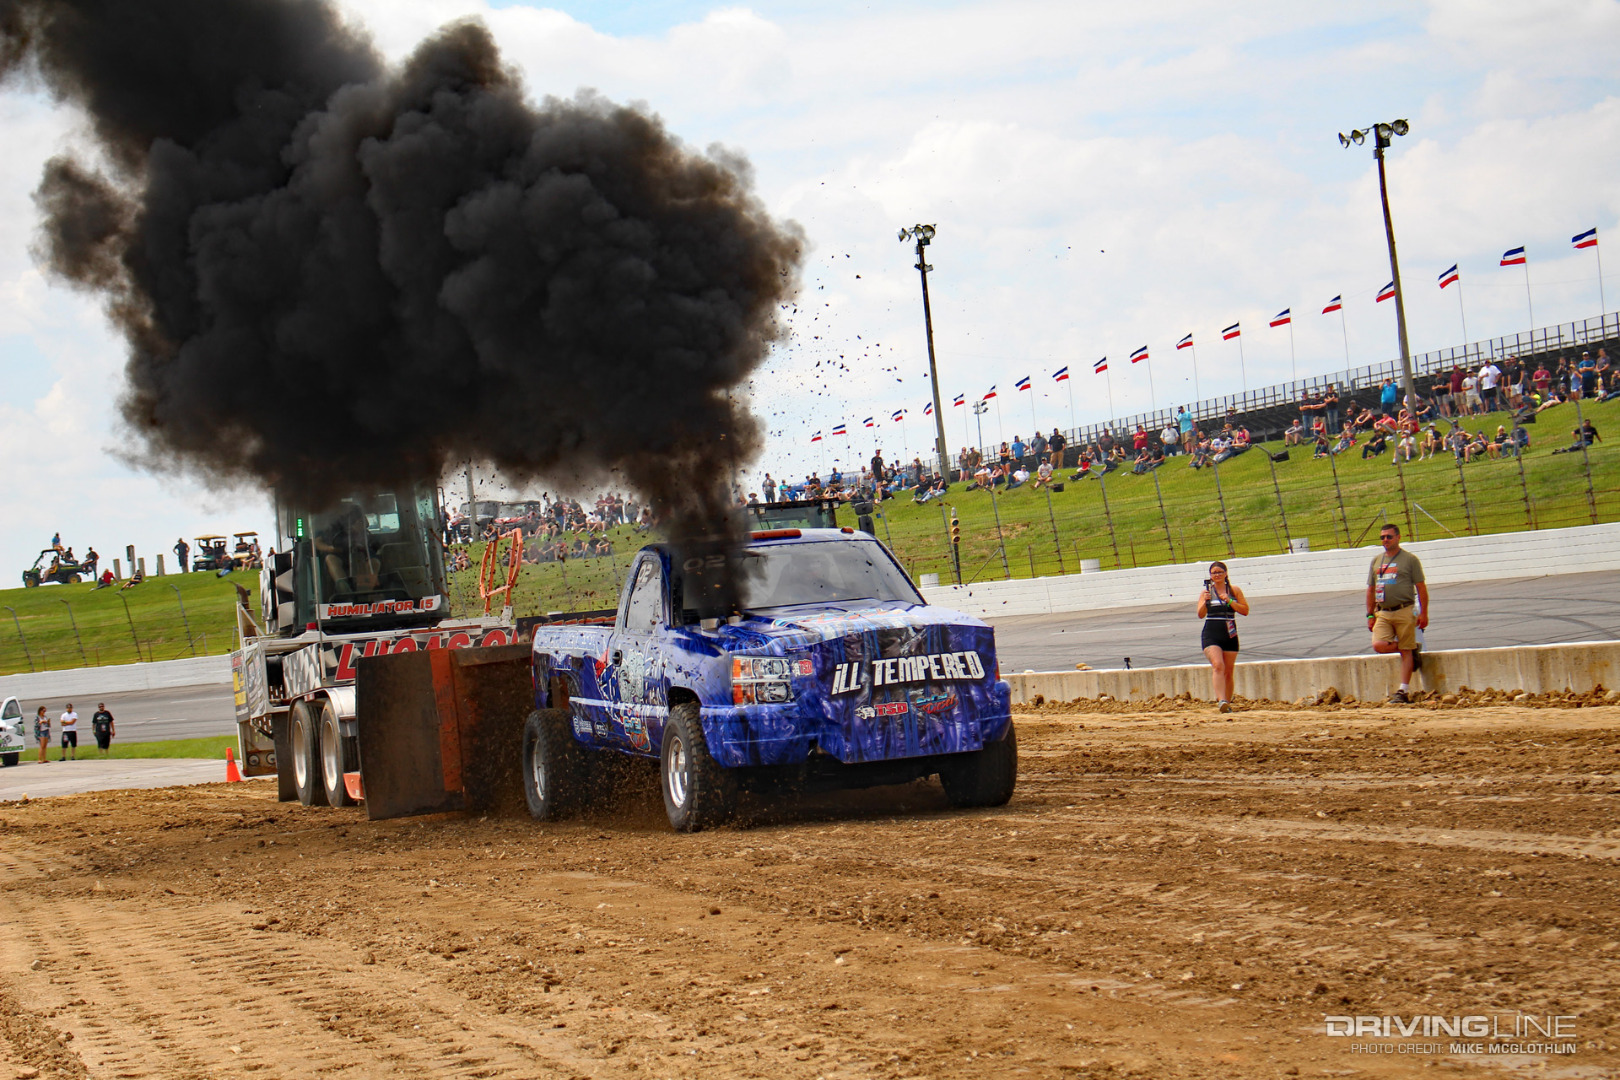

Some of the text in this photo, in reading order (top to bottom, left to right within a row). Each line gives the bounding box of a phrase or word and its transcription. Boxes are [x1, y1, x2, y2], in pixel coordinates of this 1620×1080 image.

[327, 598, 434, 617] HUMILIATOR 15
[871, 650, 986, 687] TEMPERED
[874, 702, 908, 717] TSD
